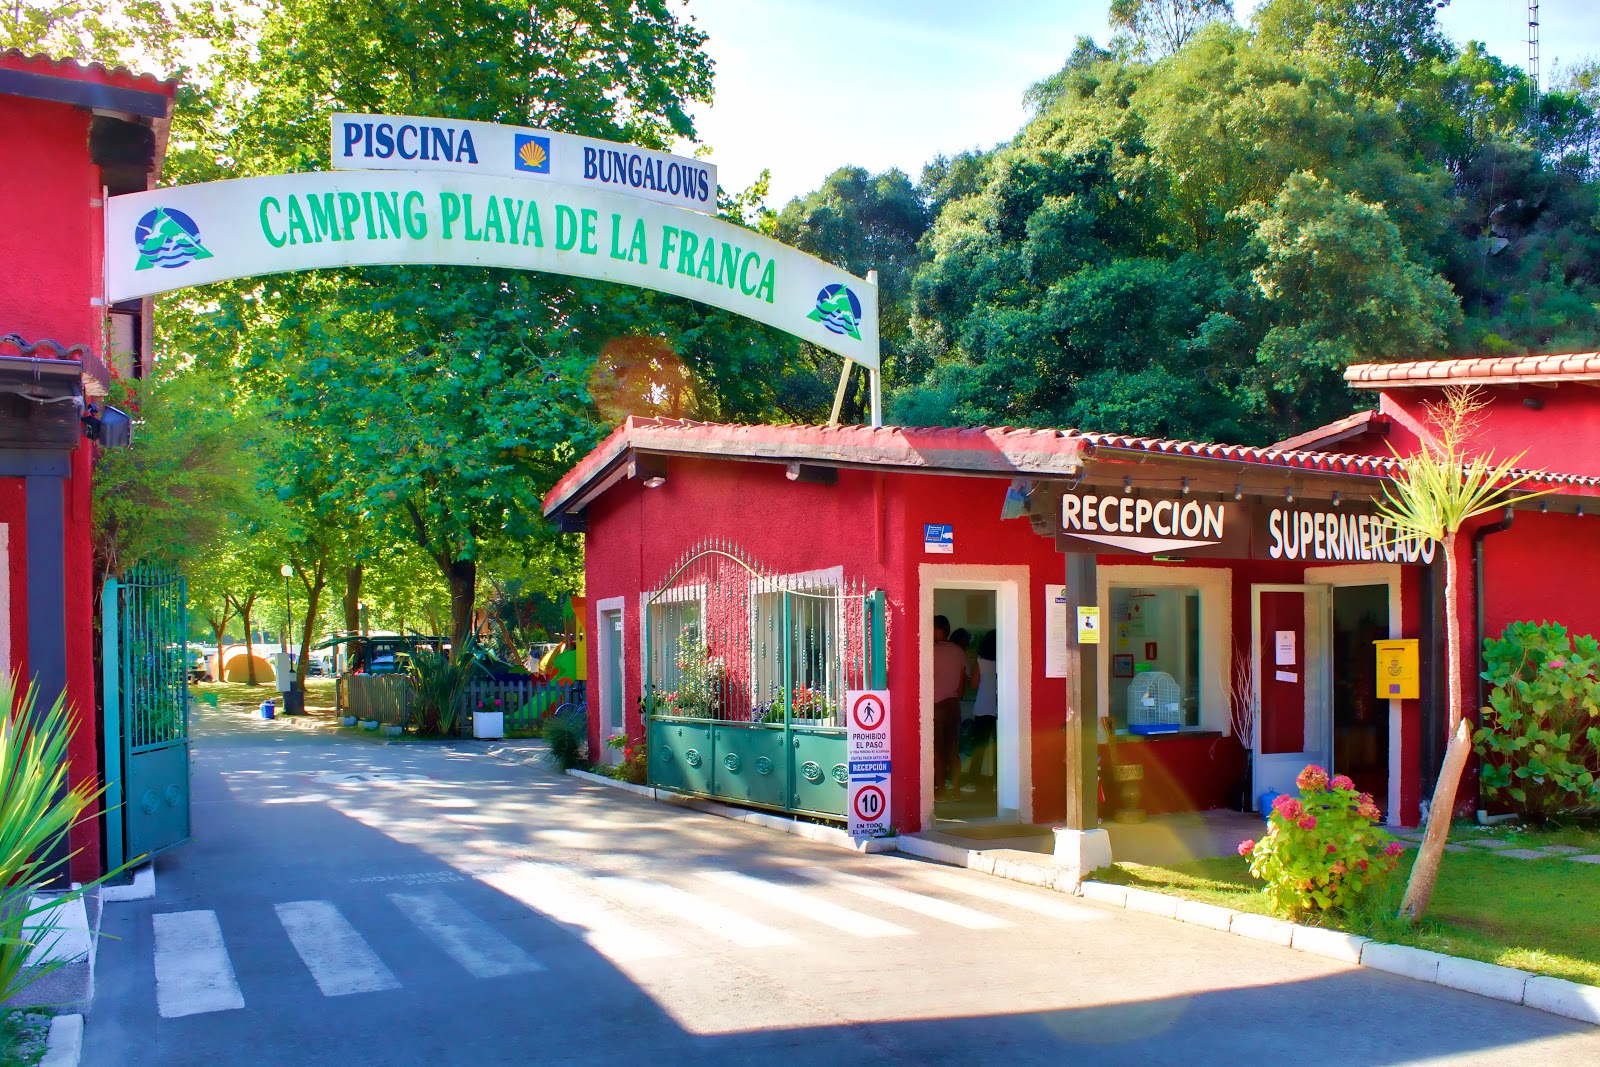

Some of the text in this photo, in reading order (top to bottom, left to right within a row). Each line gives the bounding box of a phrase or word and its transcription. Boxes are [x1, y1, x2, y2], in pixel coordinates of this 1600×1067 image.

[343, 122, 709, 202] PISCINA BUNGALOWS
[259, 190, 775, 304] CAMPING PLAYA DE LA FRANCA
[1062, 493, 1225, 539] RECEPCIÓN
[1269, 508, 1436, 564] SUPERMERCADO
[852, 732, 887, 741] PROHIBIDO
[856, 741, 883, 749] EL PASO
[852, 762, 887, 772] RECEPCIÓN
[862, 794, 878, 813] 10
